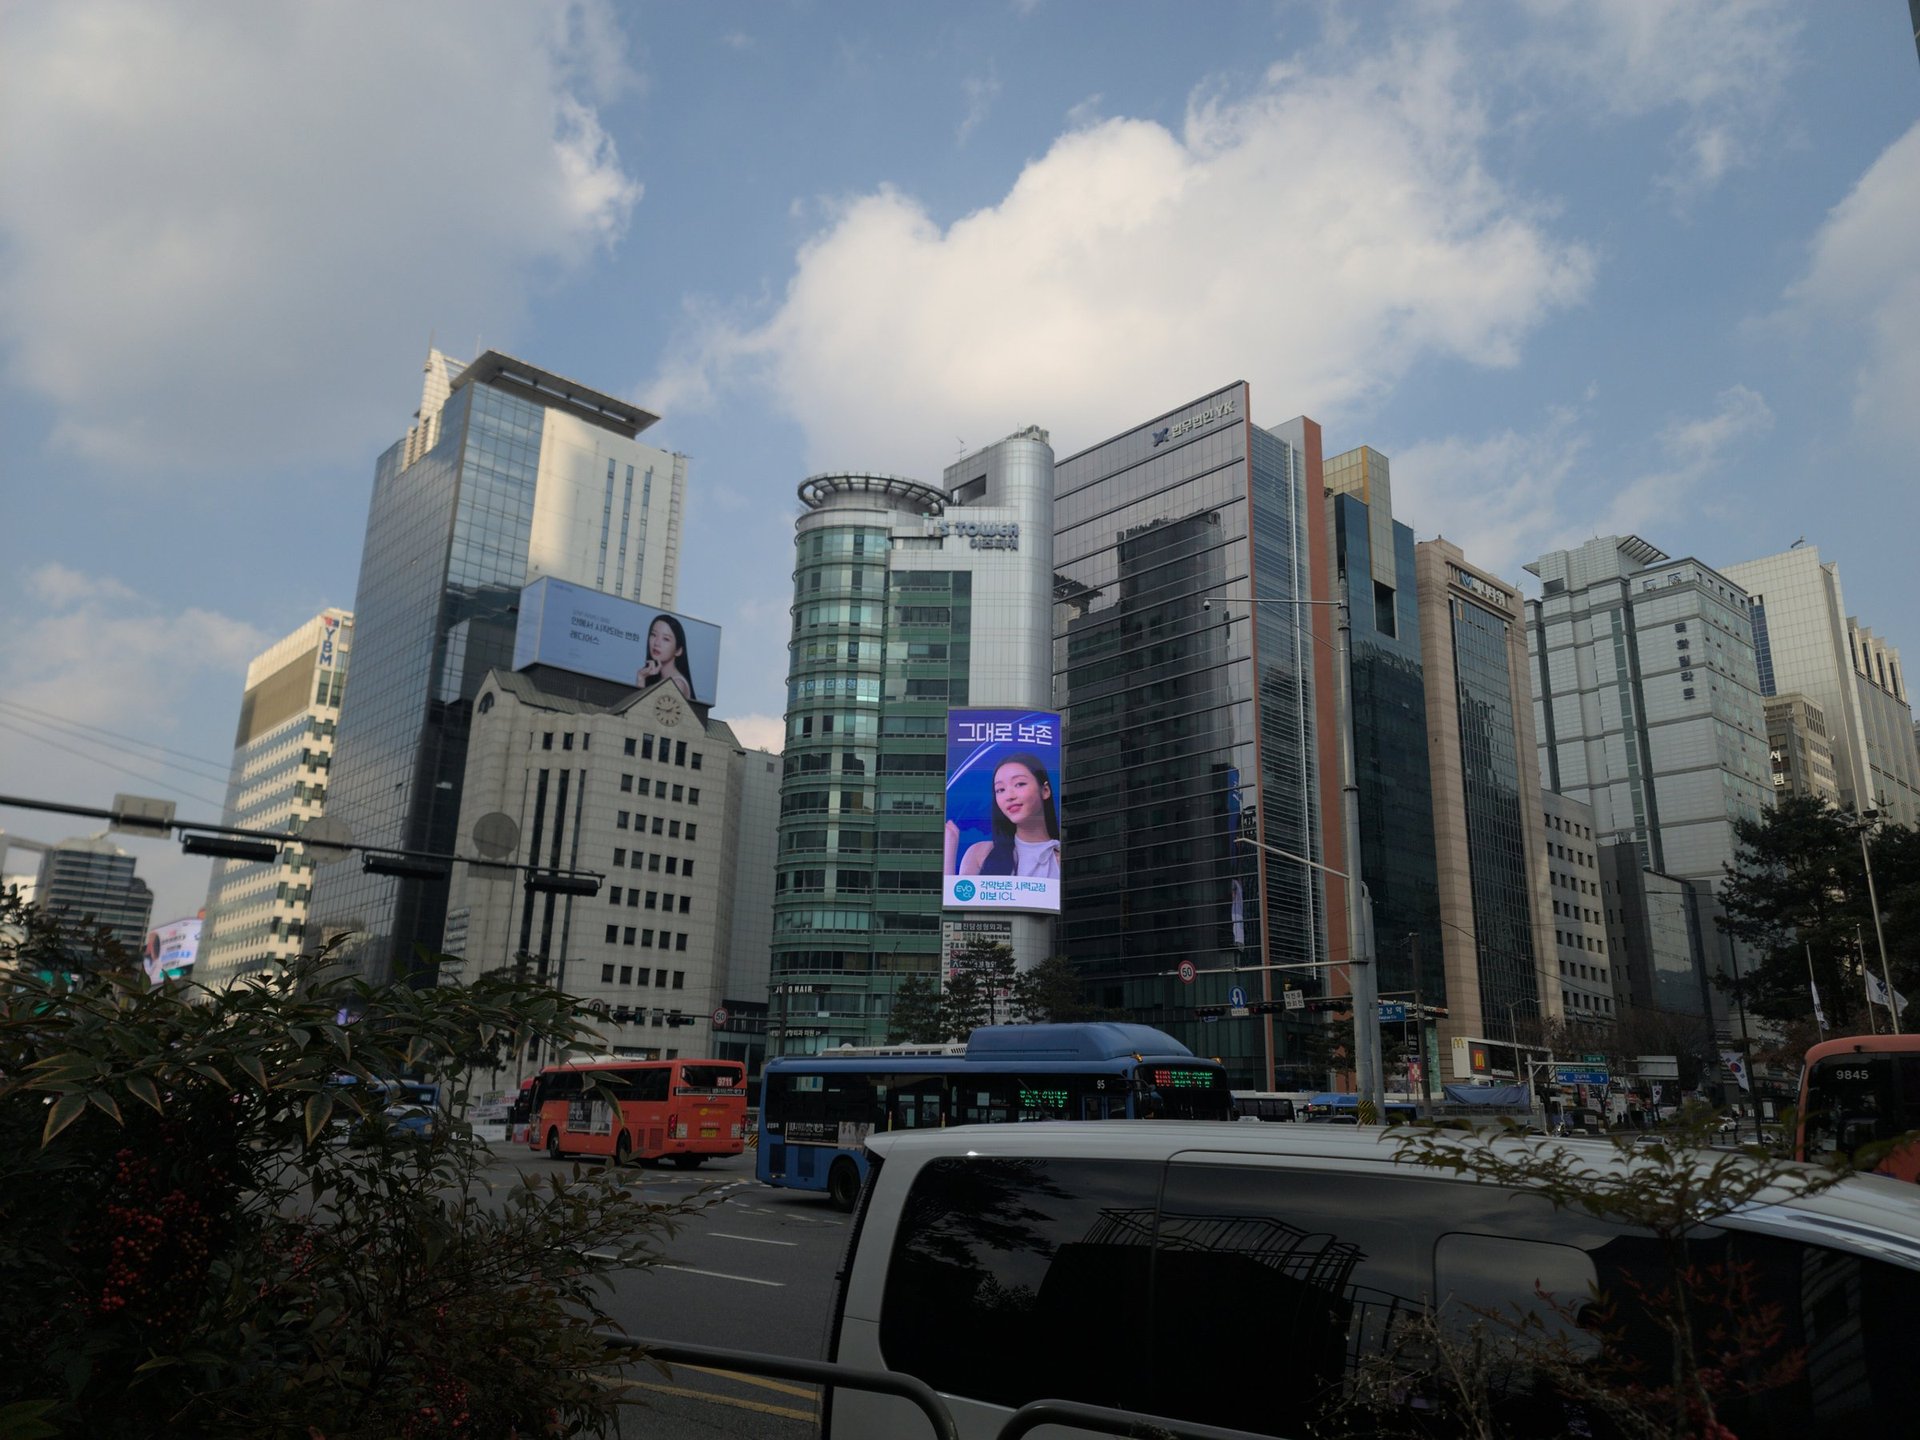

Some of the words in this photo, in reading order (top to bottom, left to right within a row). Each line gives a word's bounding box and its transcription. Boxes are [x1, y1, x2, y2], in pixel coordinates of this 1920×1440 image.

[1172, 409, 1214, 438] 법무법인
[1215, 400, 1236, 419] YK
[956, 521, 1019, 538] TOWER
[320, 627, 336, 666] YBM
[957, 722, 1013, 743] 그대로
[1018, 723, 1053, 745] 보존
[980, 880, 1013, 891] 각막보존
[1015, 882, 1047, 892] 시력교정
[980, 891, 997, 901] 이보
[999, 892, 1016, 901] ICL
[1182, 967, 1193, 977] 50
[794, 985, 813, 994] HAIR
[716, 1012, 726, 1021] 50
[1836, 1070, 1869, 1080] 9845
[717, 1076, 733, 1087] 9711
[1097, 1079, 1106, 1090] 95
